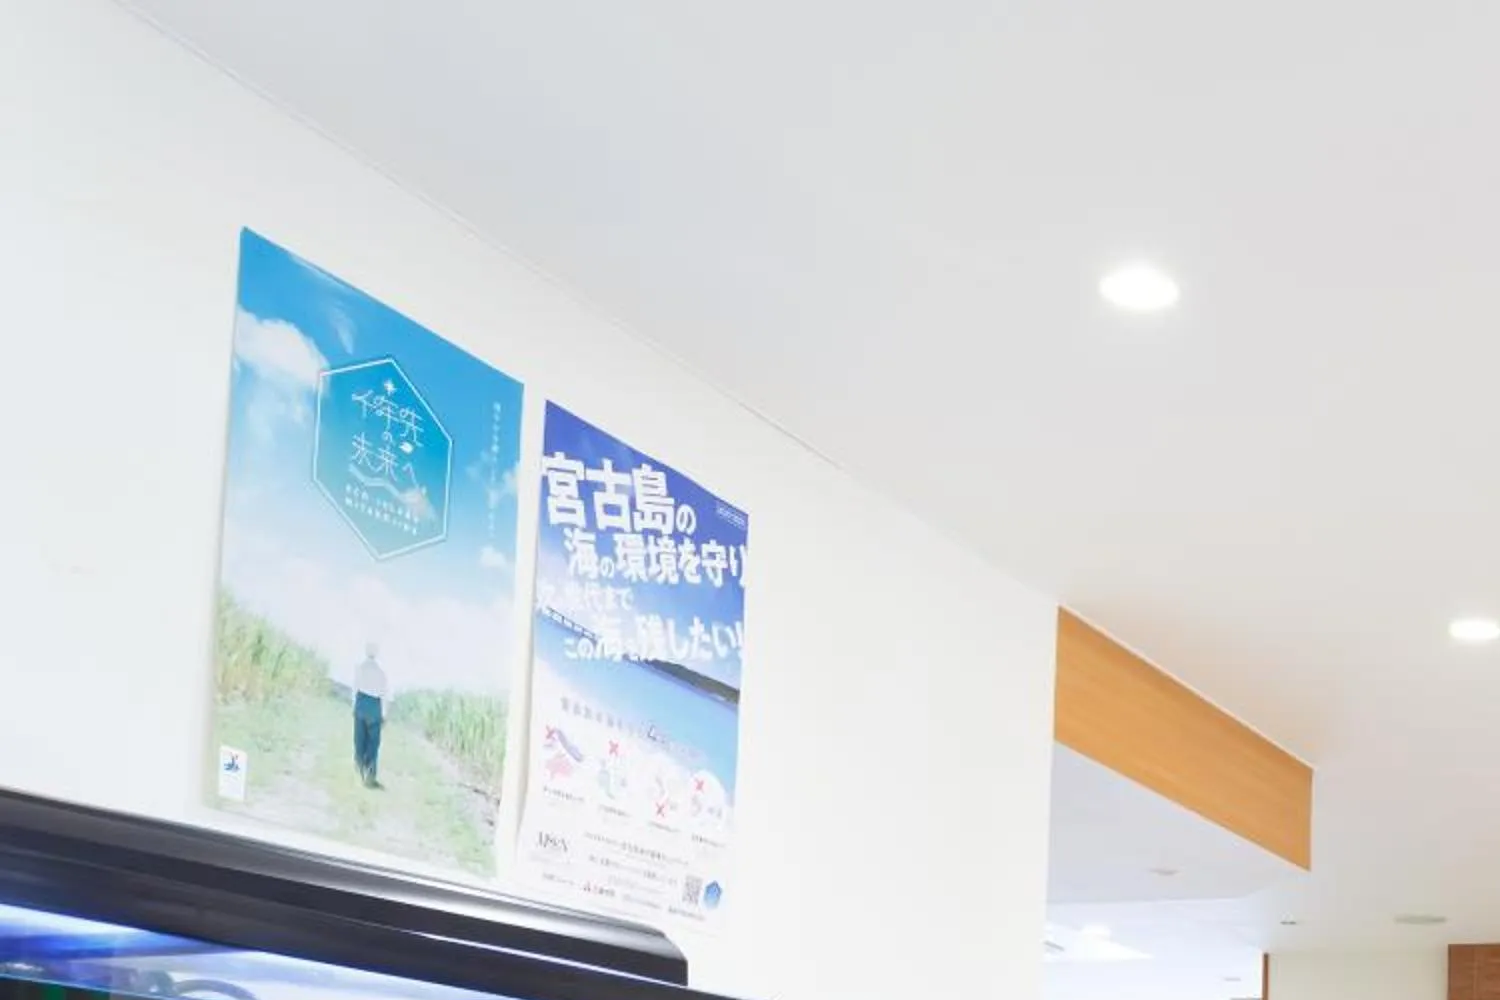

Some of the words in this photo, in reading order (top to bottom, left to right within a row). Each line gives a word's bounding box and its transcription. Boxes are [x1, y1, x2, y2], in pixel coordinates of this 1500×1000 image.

[542, 451, 697, 535] 宮古島の
[563, 527, 748, 588] 海の環境を守り
